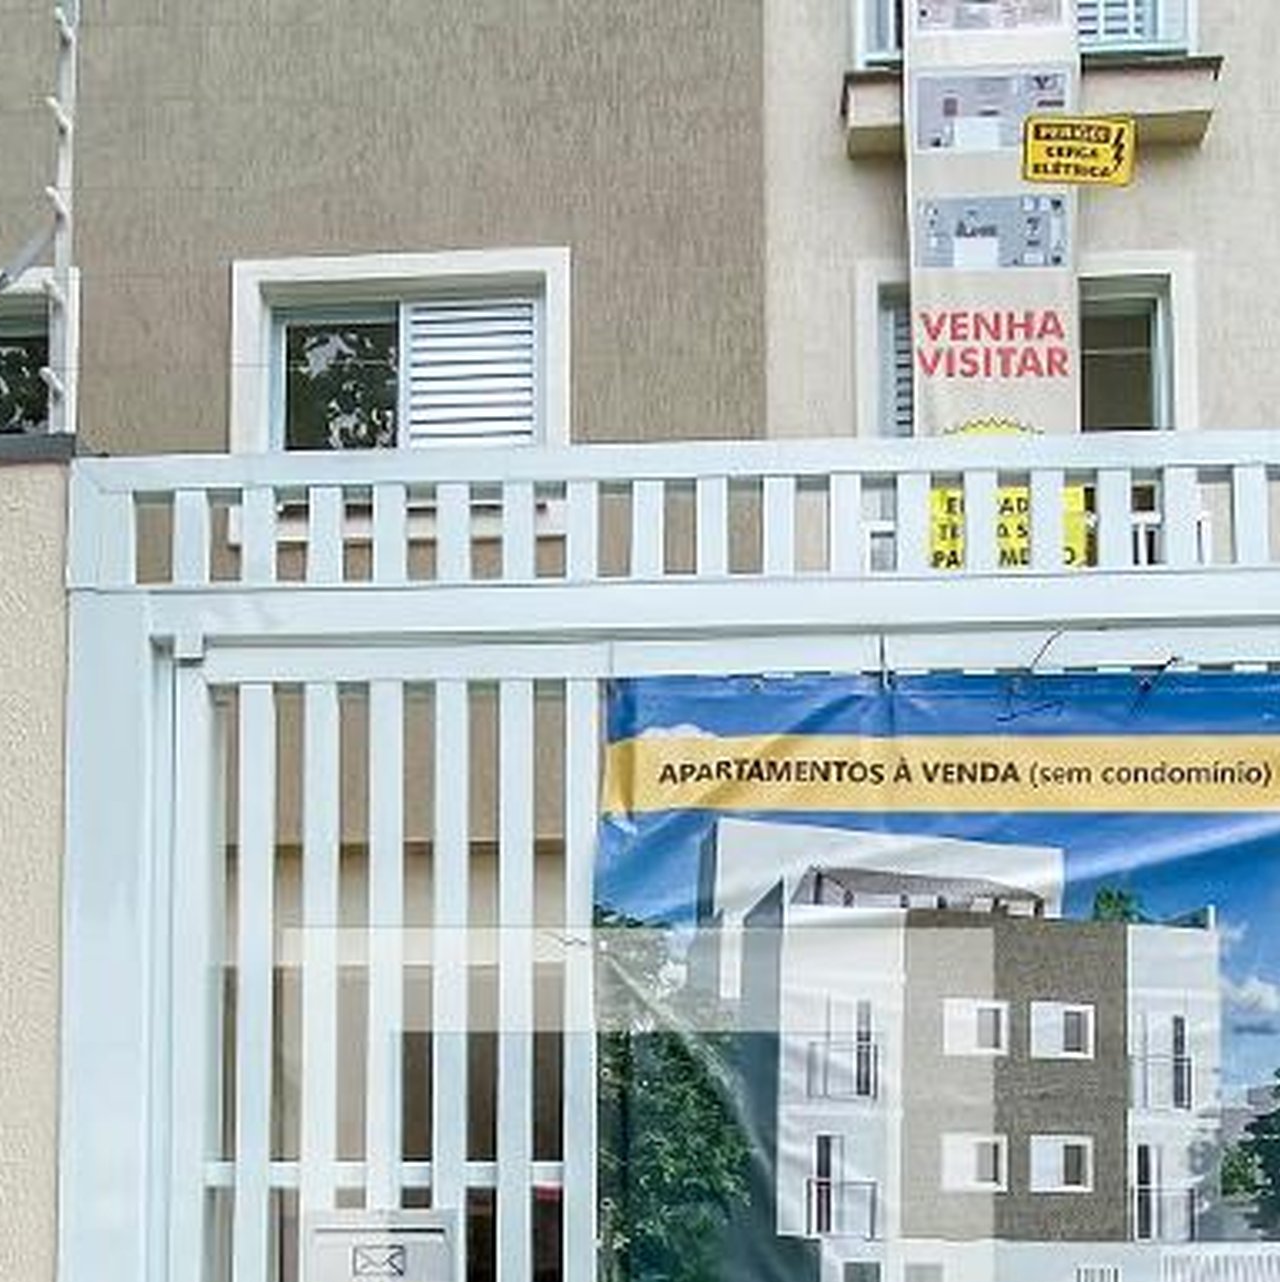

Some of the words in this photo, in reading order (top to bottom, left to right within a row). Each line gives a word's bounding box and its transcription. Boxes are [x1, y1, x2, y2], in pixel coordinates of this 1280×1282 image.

[919, 310, 1065, 341] VENHA
[917, 346, 1069, 378] VISITAR
[659, 758, 885, 785] APARTAMENTOS
[893, 757, 912, 783] À
[921, 761, 1020, 784] VENDA
[1030, 761, 1092, 788] (sem
[1101, 761, 1272, 787] condomínio)
